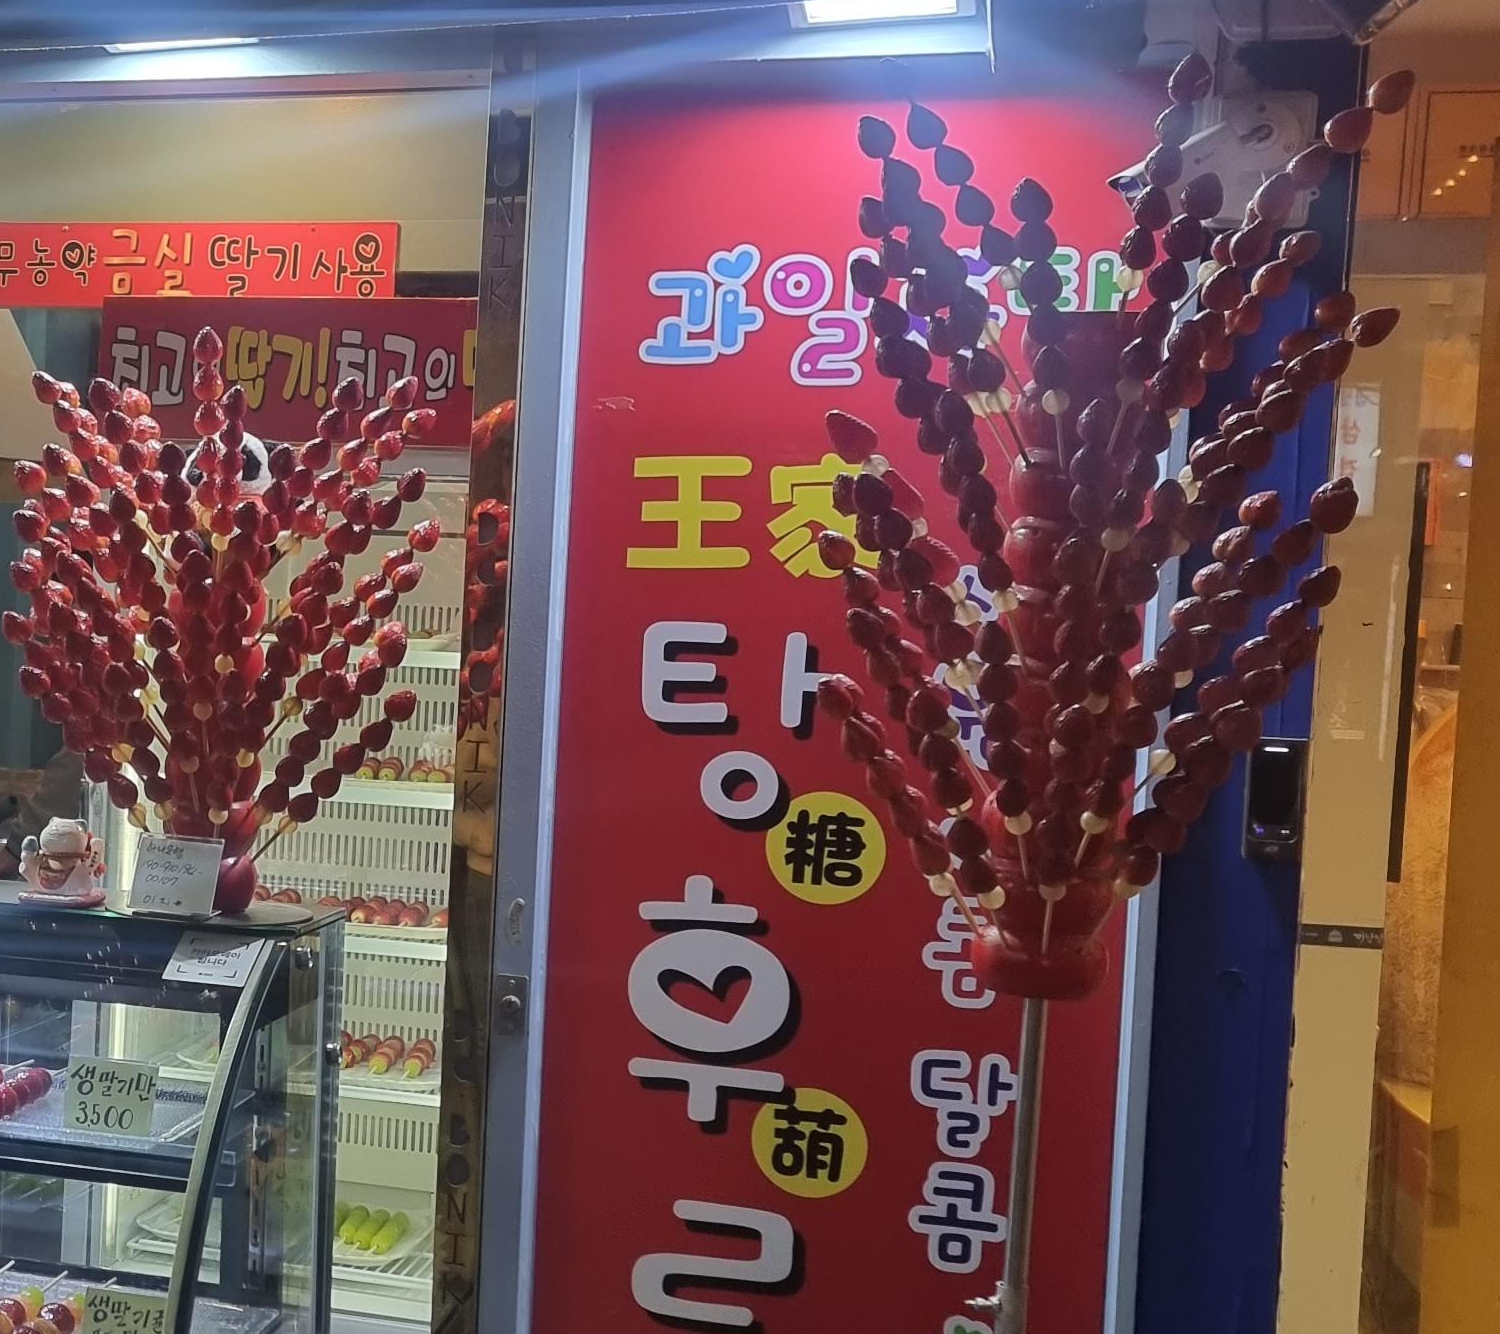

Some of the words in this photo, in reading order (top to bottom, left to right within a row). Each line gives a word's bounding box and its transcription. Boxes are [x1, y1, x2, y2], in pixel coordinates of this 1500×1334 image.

[783, 809, 869, 888] 糖
[770, 1105, 849, 1185] 葫
[909, 1050, 1018, 1274] 달콤
